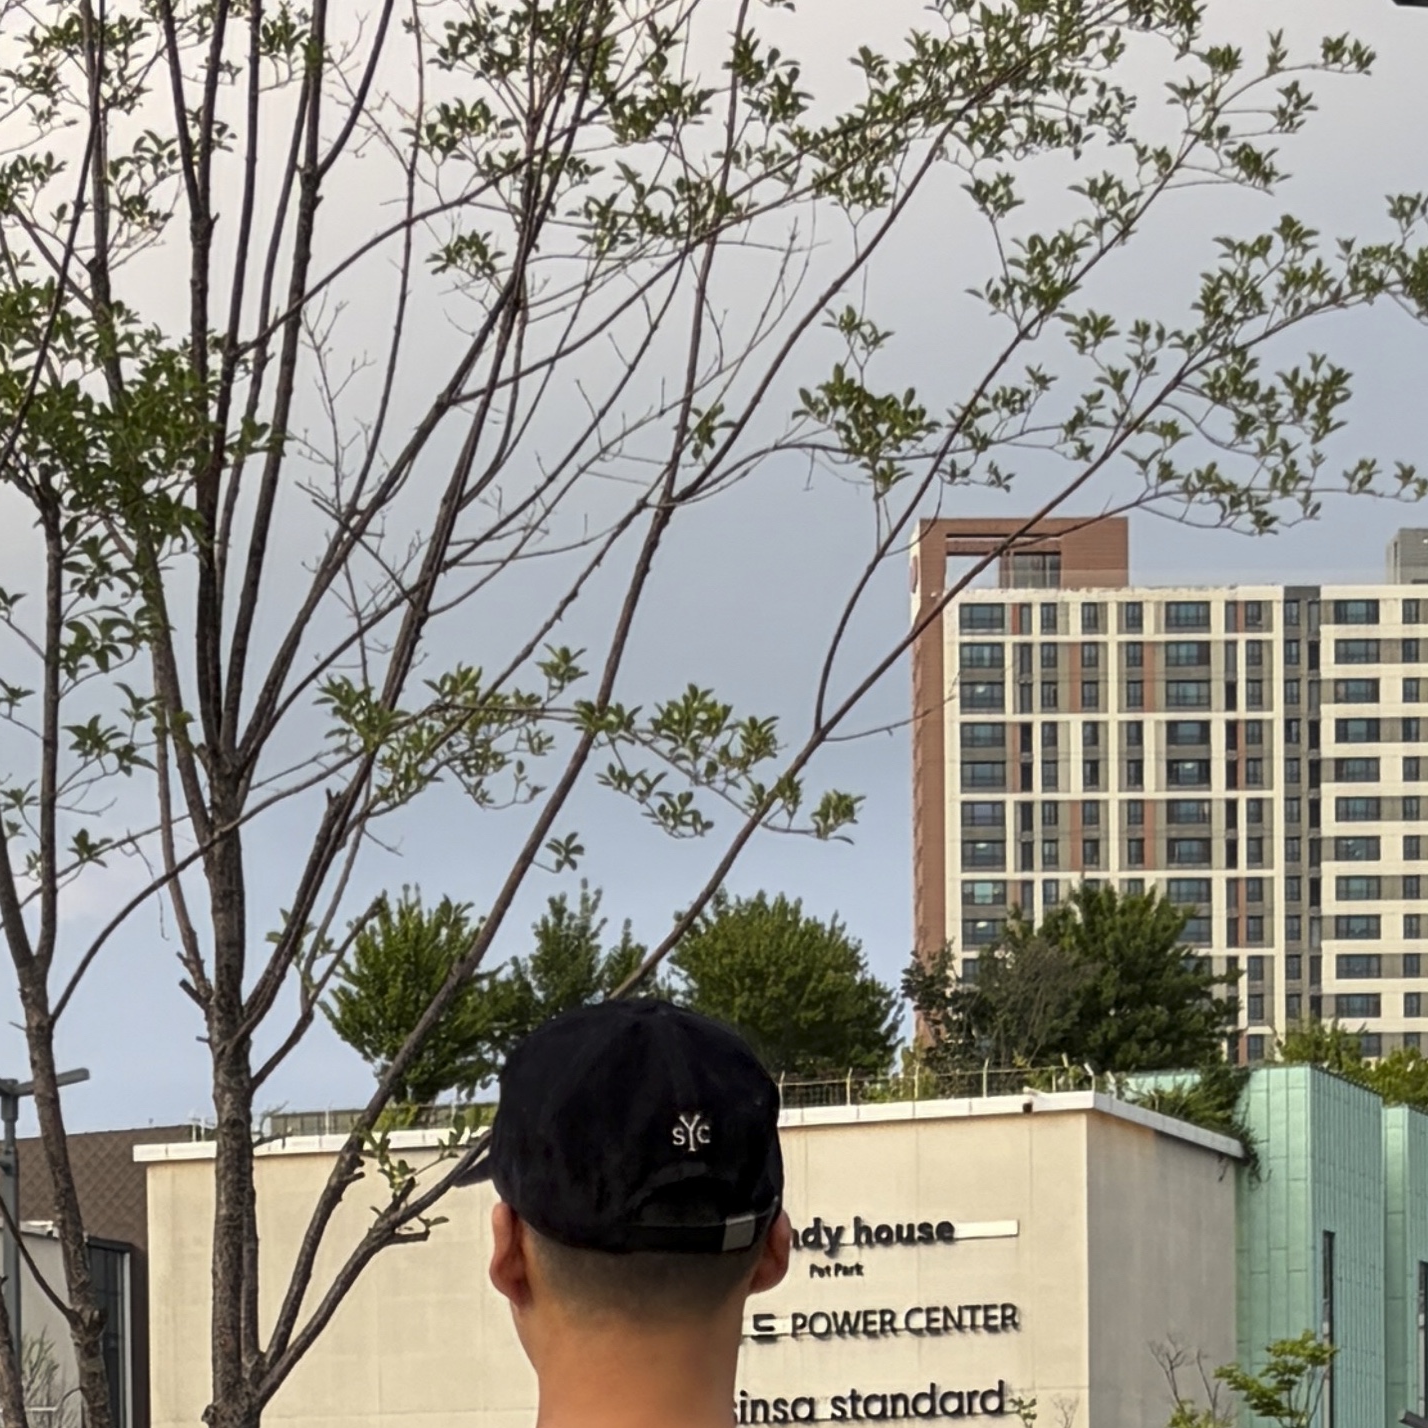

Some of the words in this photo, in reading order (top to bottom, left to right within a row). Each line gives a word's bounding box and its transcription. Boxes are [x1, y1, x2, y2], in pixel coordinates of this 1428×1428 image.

[853, 1216, 955, 1248] house
[834, 1262, 864, 1278] Park
[791, 1308, 897, 1338] POWER
[904, 1303, 1019, 1335] CENTER
[830, 1382, 1005, 1420] standard
